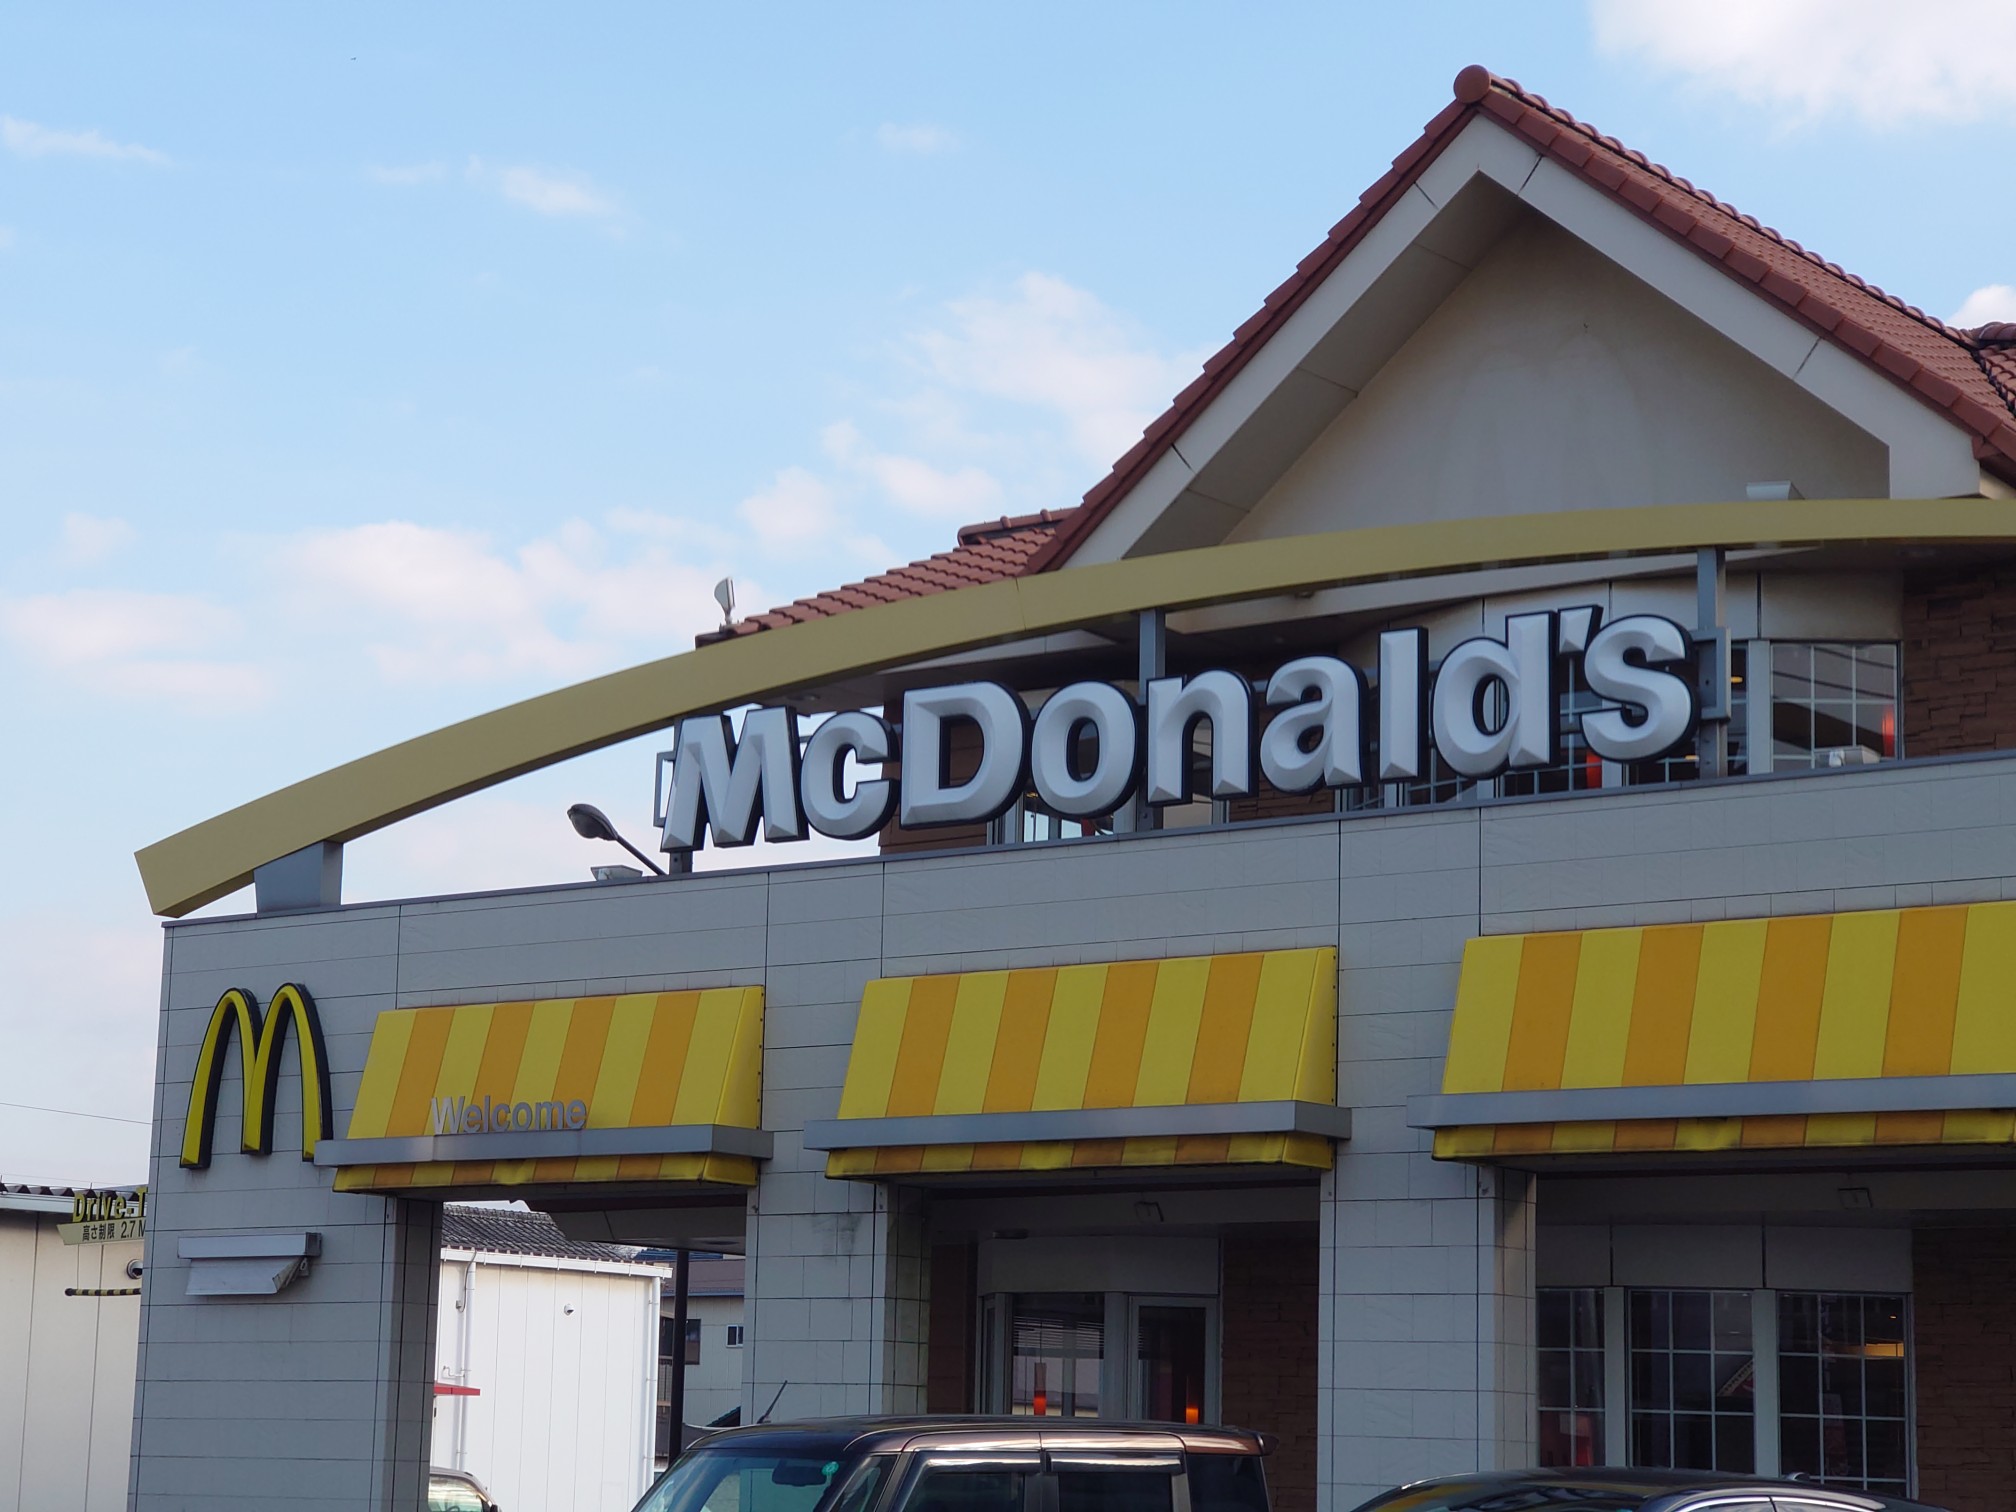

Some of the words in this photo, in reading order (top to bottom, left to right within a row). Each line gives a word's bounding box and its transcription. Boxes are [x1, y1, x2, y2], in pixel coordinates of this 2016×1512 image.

[660, 604, 1699, 853] McDonald's
[431, 1095, 587, 1135] Welcome
[82, 1223, 115, 1242] 高さ制限
[120, 1220, 136, 1239] 2.7
